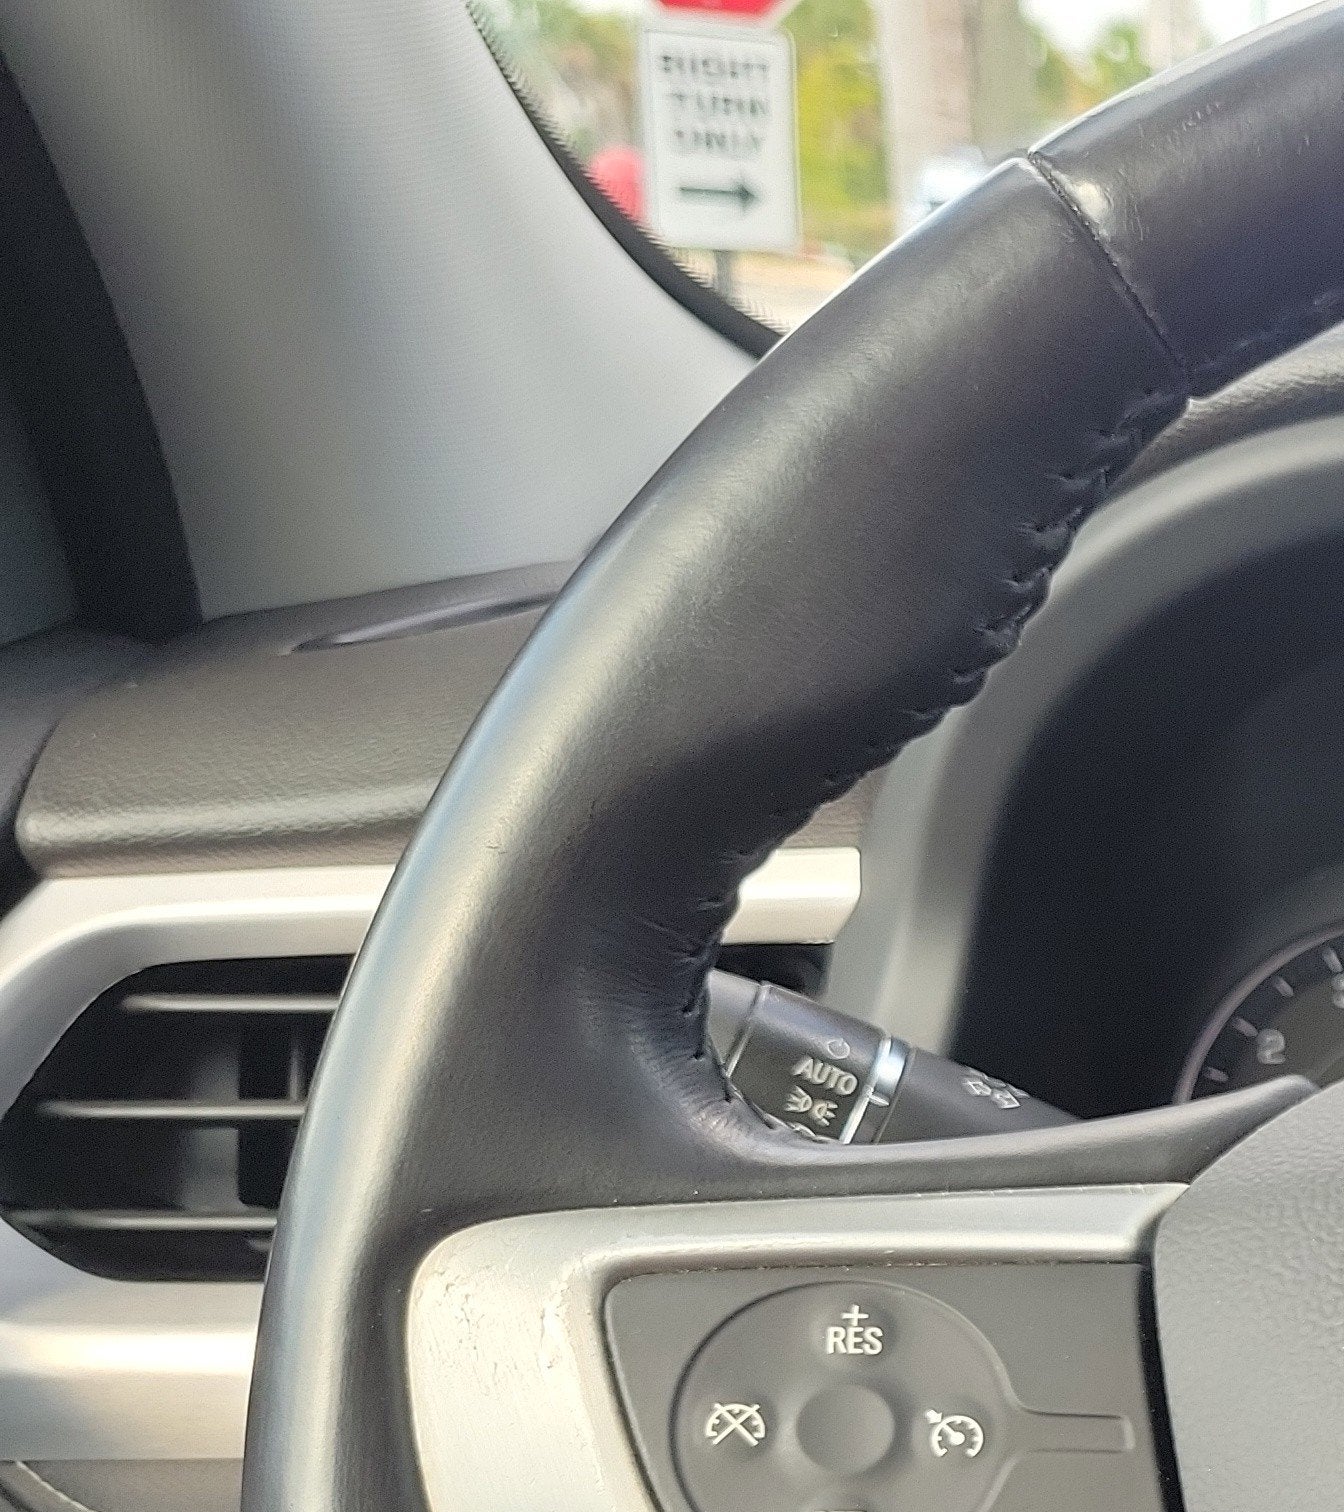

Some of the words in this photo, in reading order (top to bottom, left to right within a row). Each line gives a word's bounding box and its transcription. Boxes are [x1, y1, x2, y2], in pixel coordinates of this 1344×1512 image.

[1255, 1029, 1287, 1066] 2
[791, 1055, 858, 1096] AUTO
[825, 1325, 884, 1356] RES
